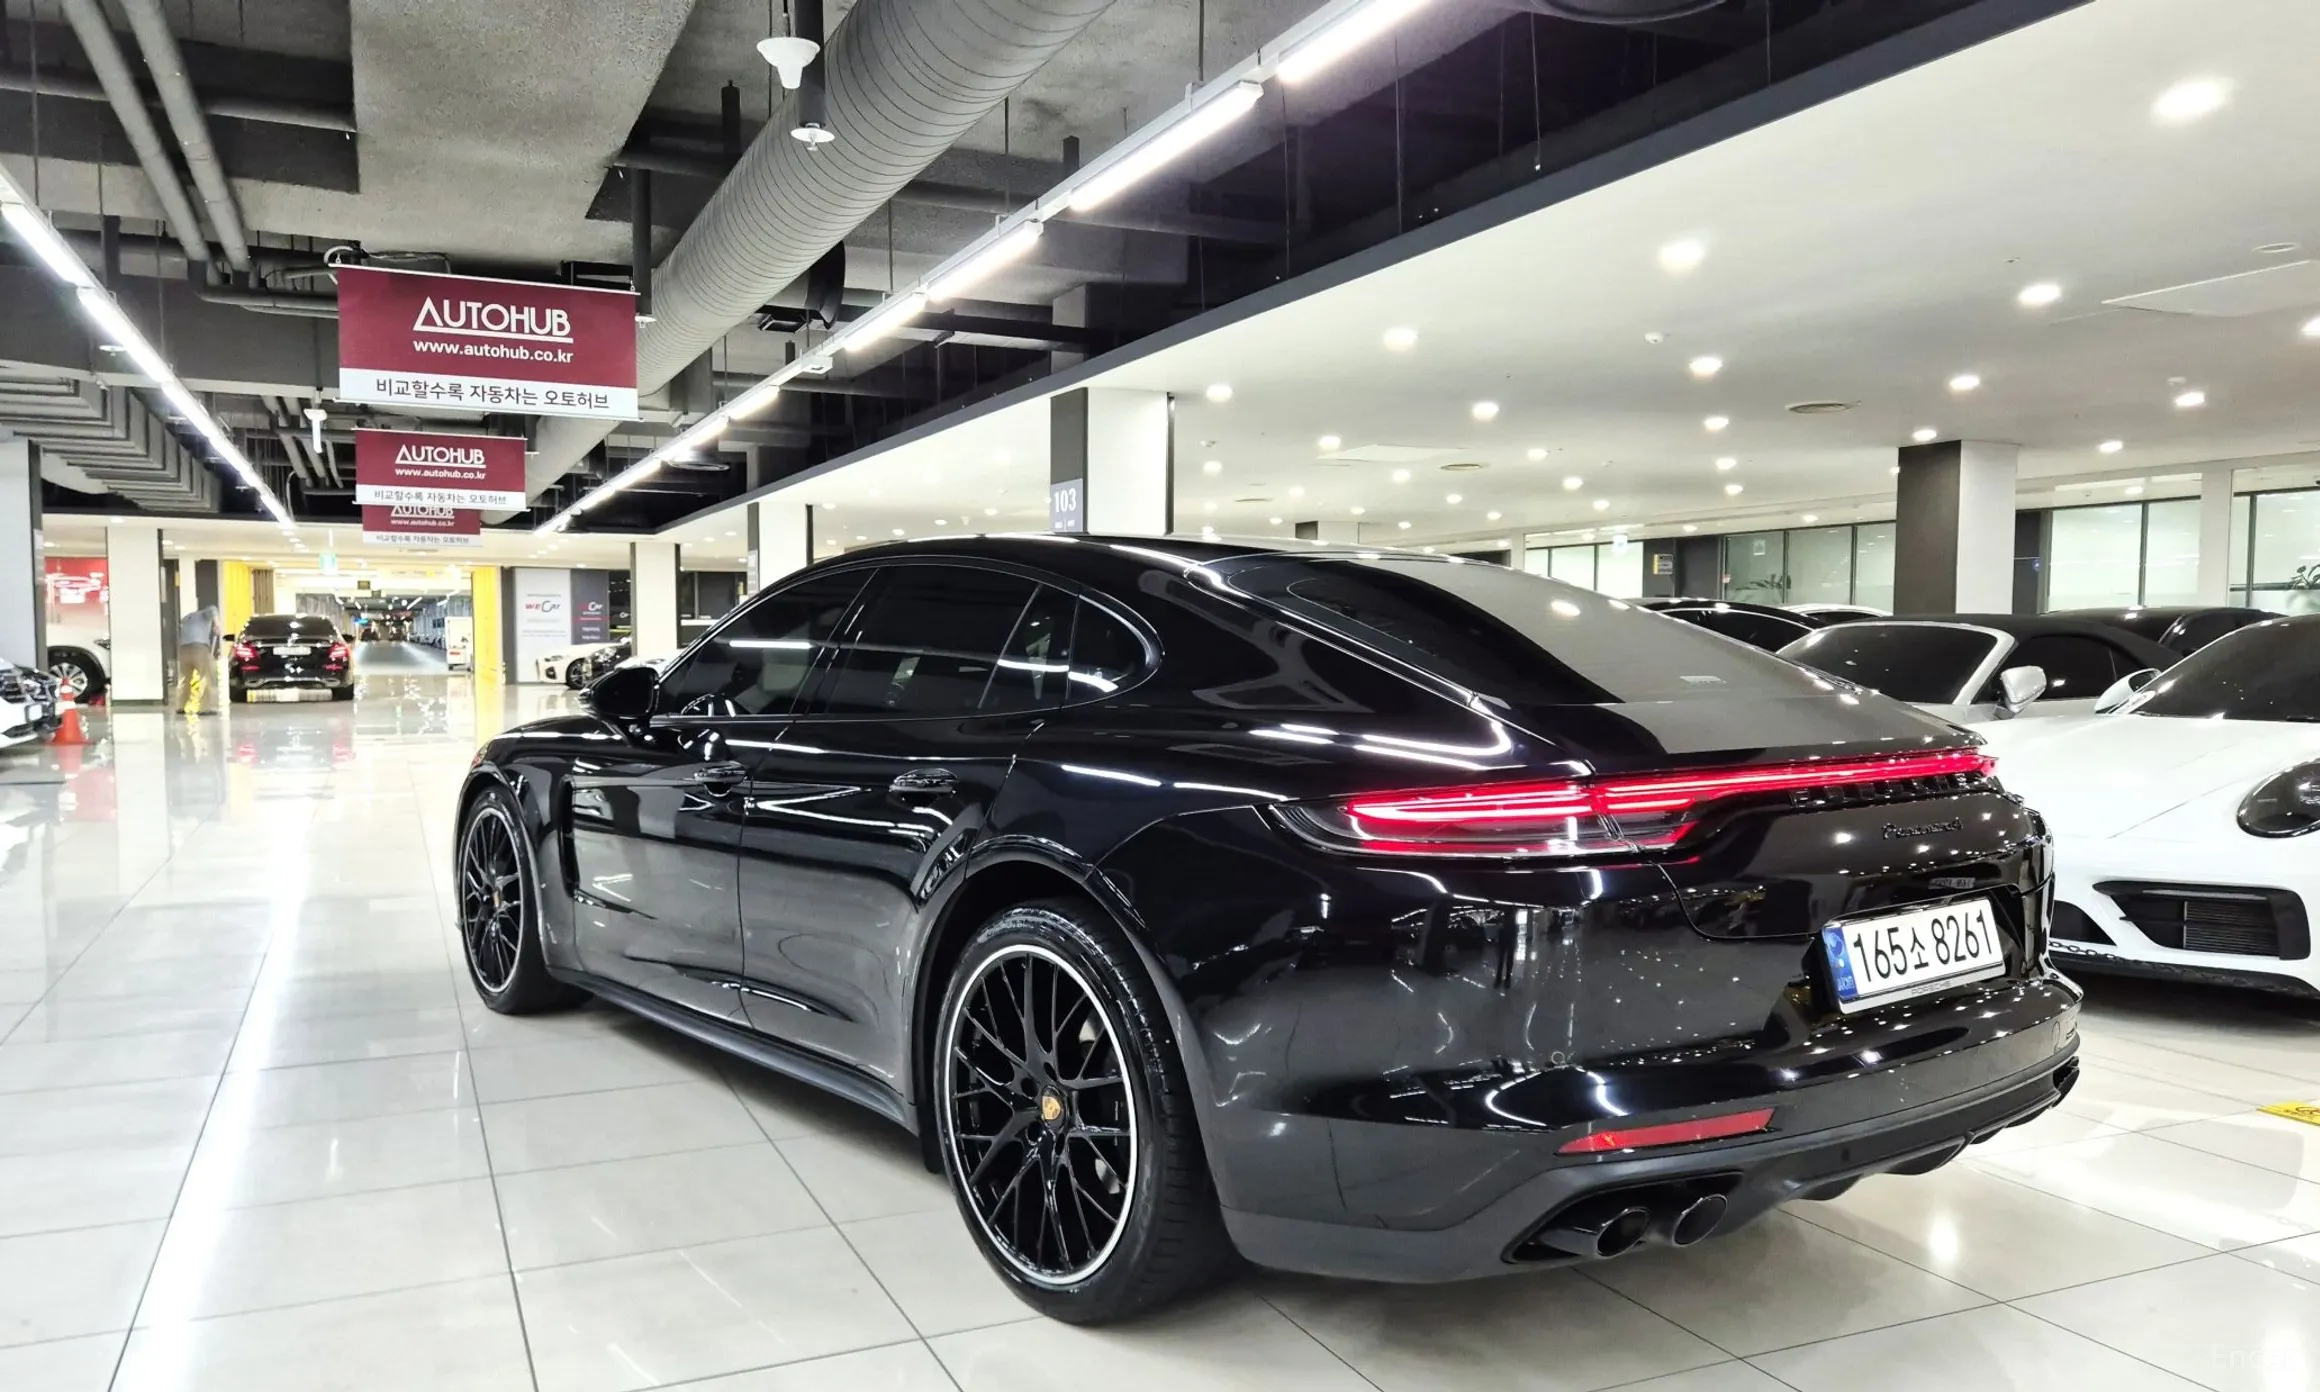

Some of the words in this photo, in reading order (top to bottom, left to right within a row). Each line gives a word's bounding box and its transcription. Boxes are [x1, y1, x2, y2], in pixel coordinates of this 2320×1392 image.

[413, 296, 573, 340] AUTOHUB
[413, 339, 573, 363] www.autohub.co.kr
[376, 378, 464, 401] 비교할수록
[470, 384, 538, 406] 자동차는
[544, 390, 609, 410] 오토허브
[395, 444, 486, 467] AUTOHUB
[395, 467, 486, 480] www.autohub.co.kr
[374, 489, 424, 502] 비교할수록
[427, 492, 465, 504] 자동차는
[469, 493, 507, 505] 오토허브
[1054, 488, 1077, 513] 103
[391, 506, 454, 518] AUTOHUB
[1853, 926, 1929, 982] 165소
[1931, 909, 1992, 965] 8261
